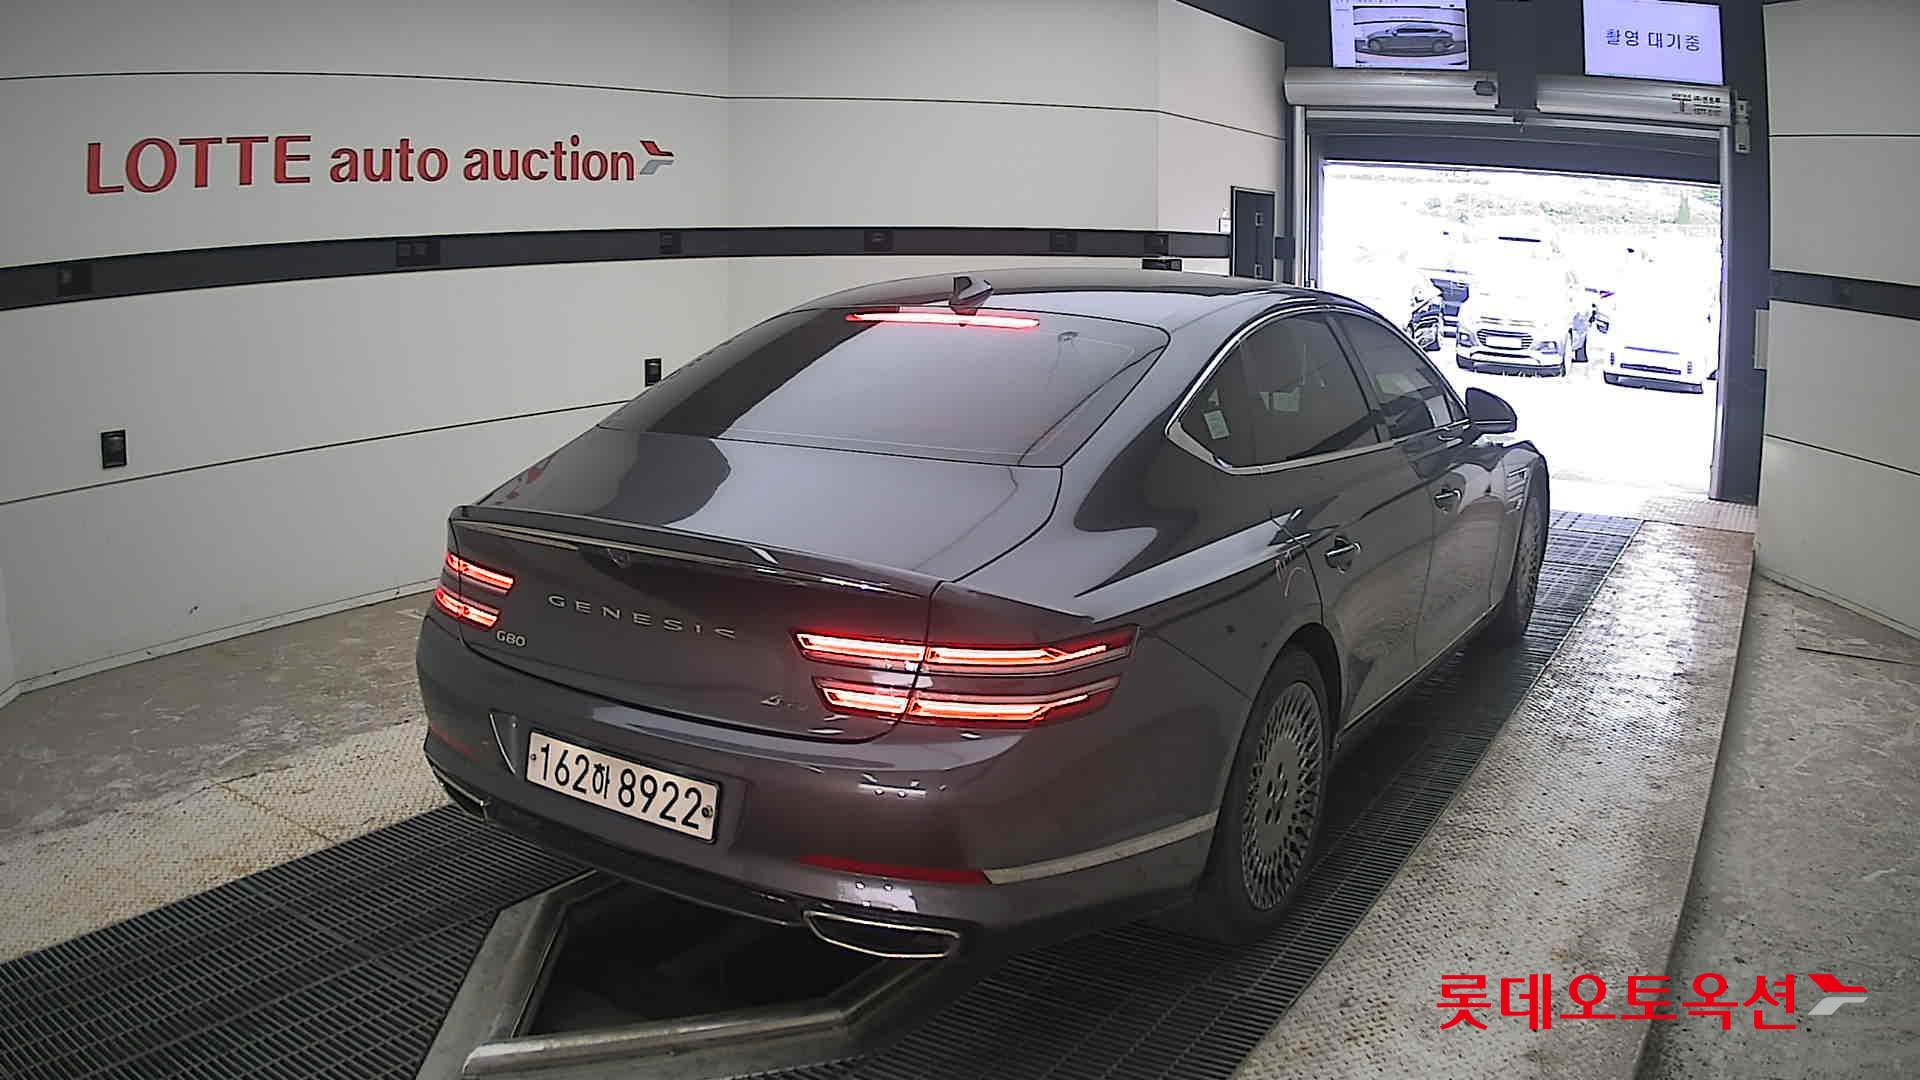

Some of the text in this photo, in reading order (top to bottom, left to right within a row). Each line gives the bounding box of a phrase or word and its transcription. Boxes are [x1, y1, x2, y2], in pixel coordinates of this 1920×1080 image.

[1606, 28, 1640, 47] 촬영
[86, 134, 636, 195] LOTTE auto auction
[547, 594, 737, 640] GENESIS
[495, 629, 527, 648] G80
